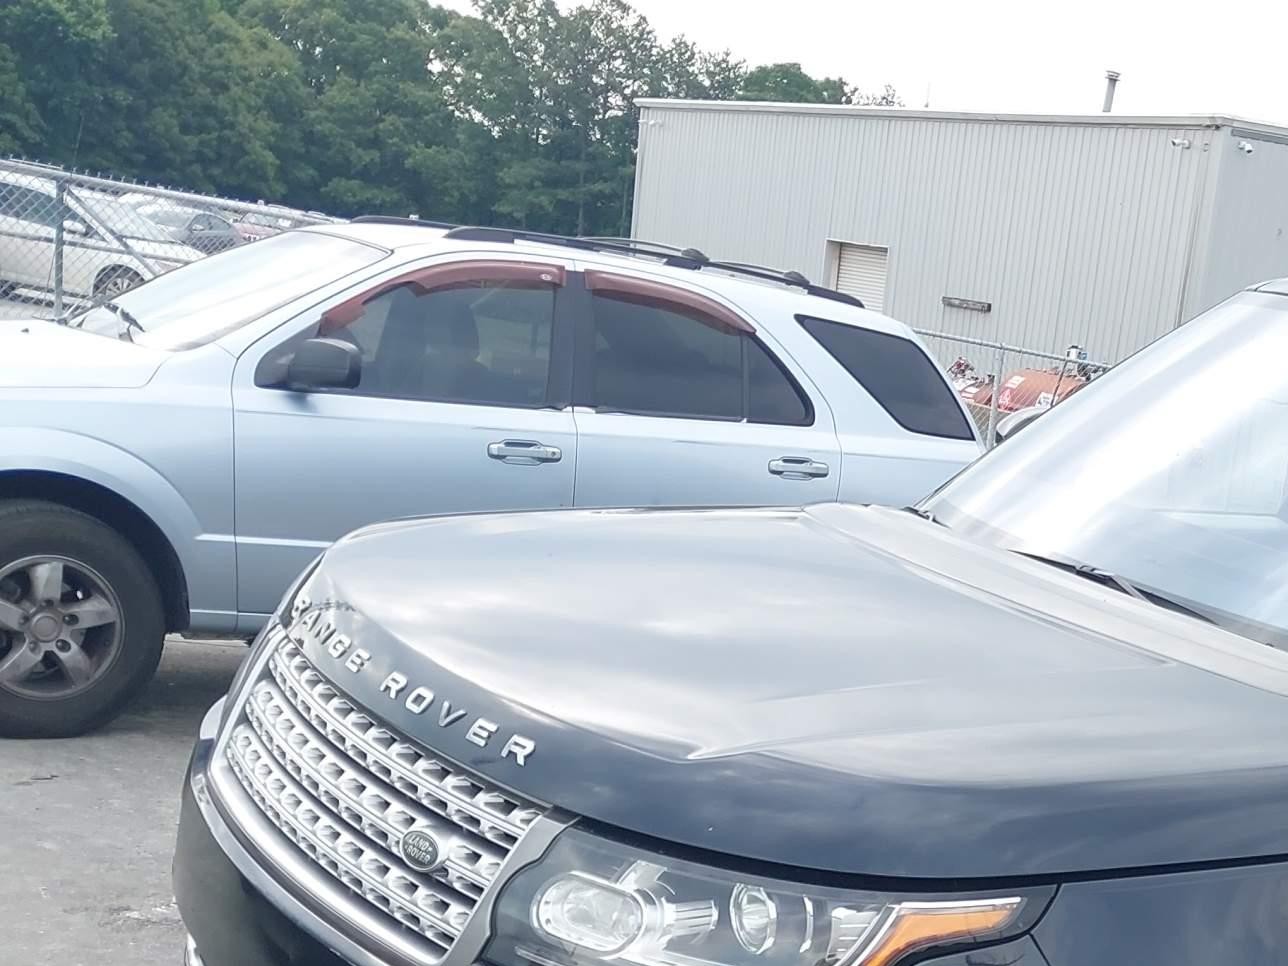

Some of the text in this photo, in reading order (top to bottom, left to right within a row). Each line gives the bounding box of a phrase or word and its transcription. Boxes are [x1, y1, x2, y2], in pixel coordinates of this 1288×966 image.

[291, 596, 536, 767] RANGE ROVER
[409, 834, 430, 851] LAND
[406, 845, 431, 865] ROVER
